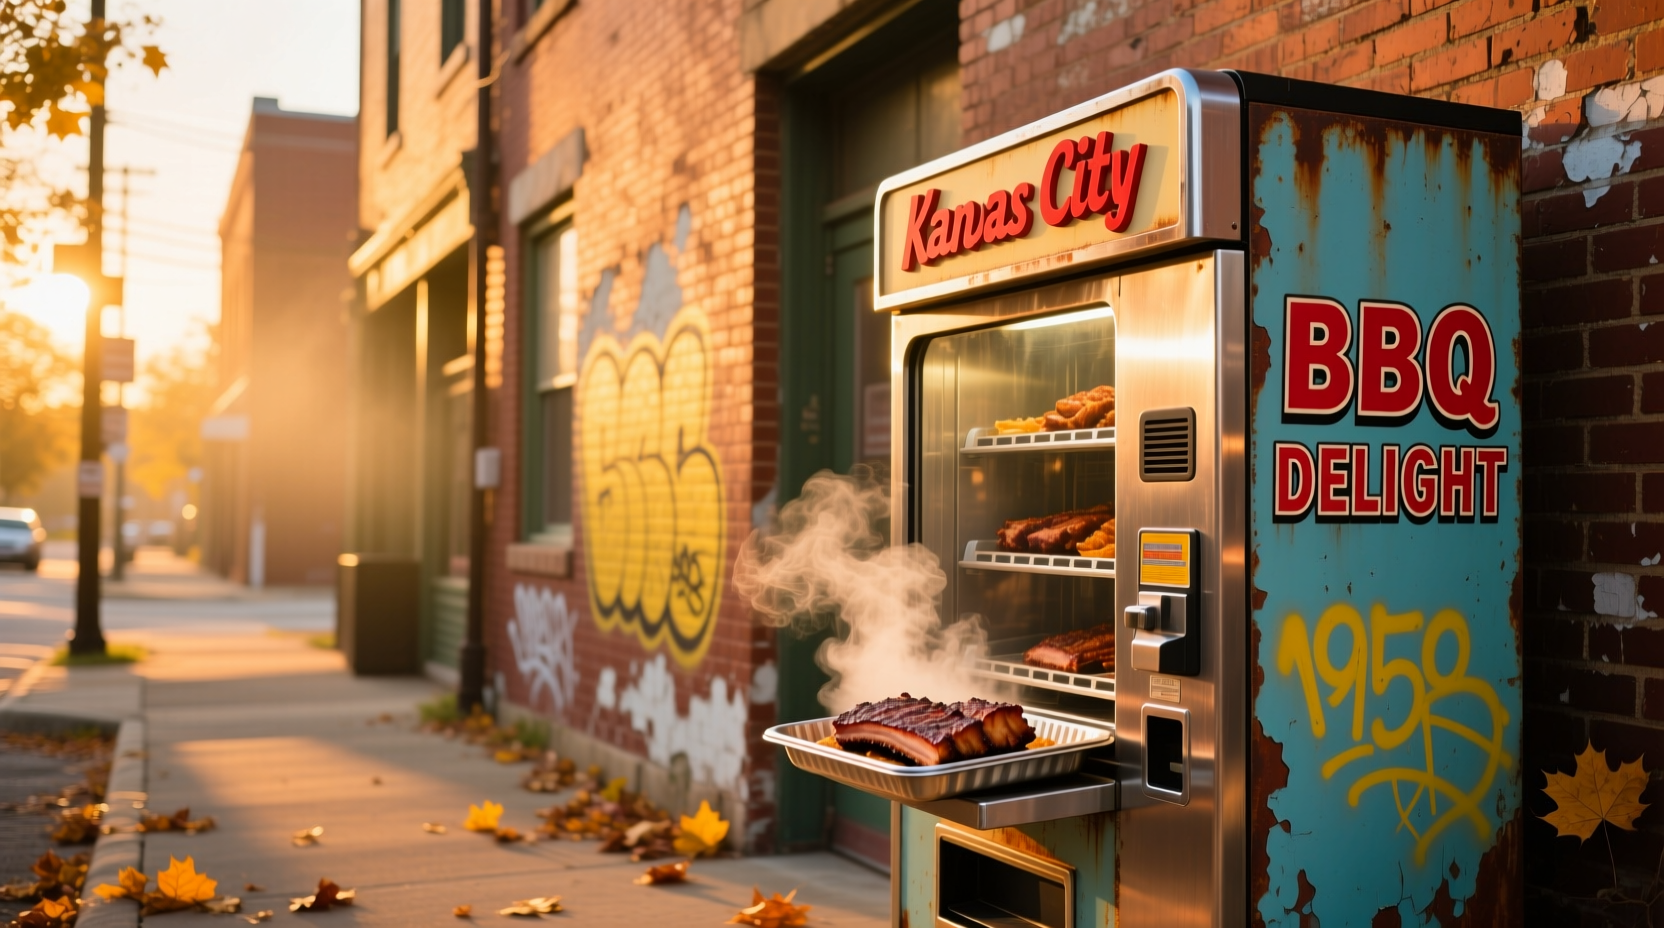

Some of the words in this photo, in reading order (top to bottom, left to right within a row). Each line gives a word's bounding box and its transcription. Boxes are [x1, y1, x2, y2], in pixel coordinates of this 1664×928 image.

[1040, 131, 1148, 233] City
[1281, 293, 1500, 439] BBQ
[1273, 440, 1508, 525] DELIGHT
